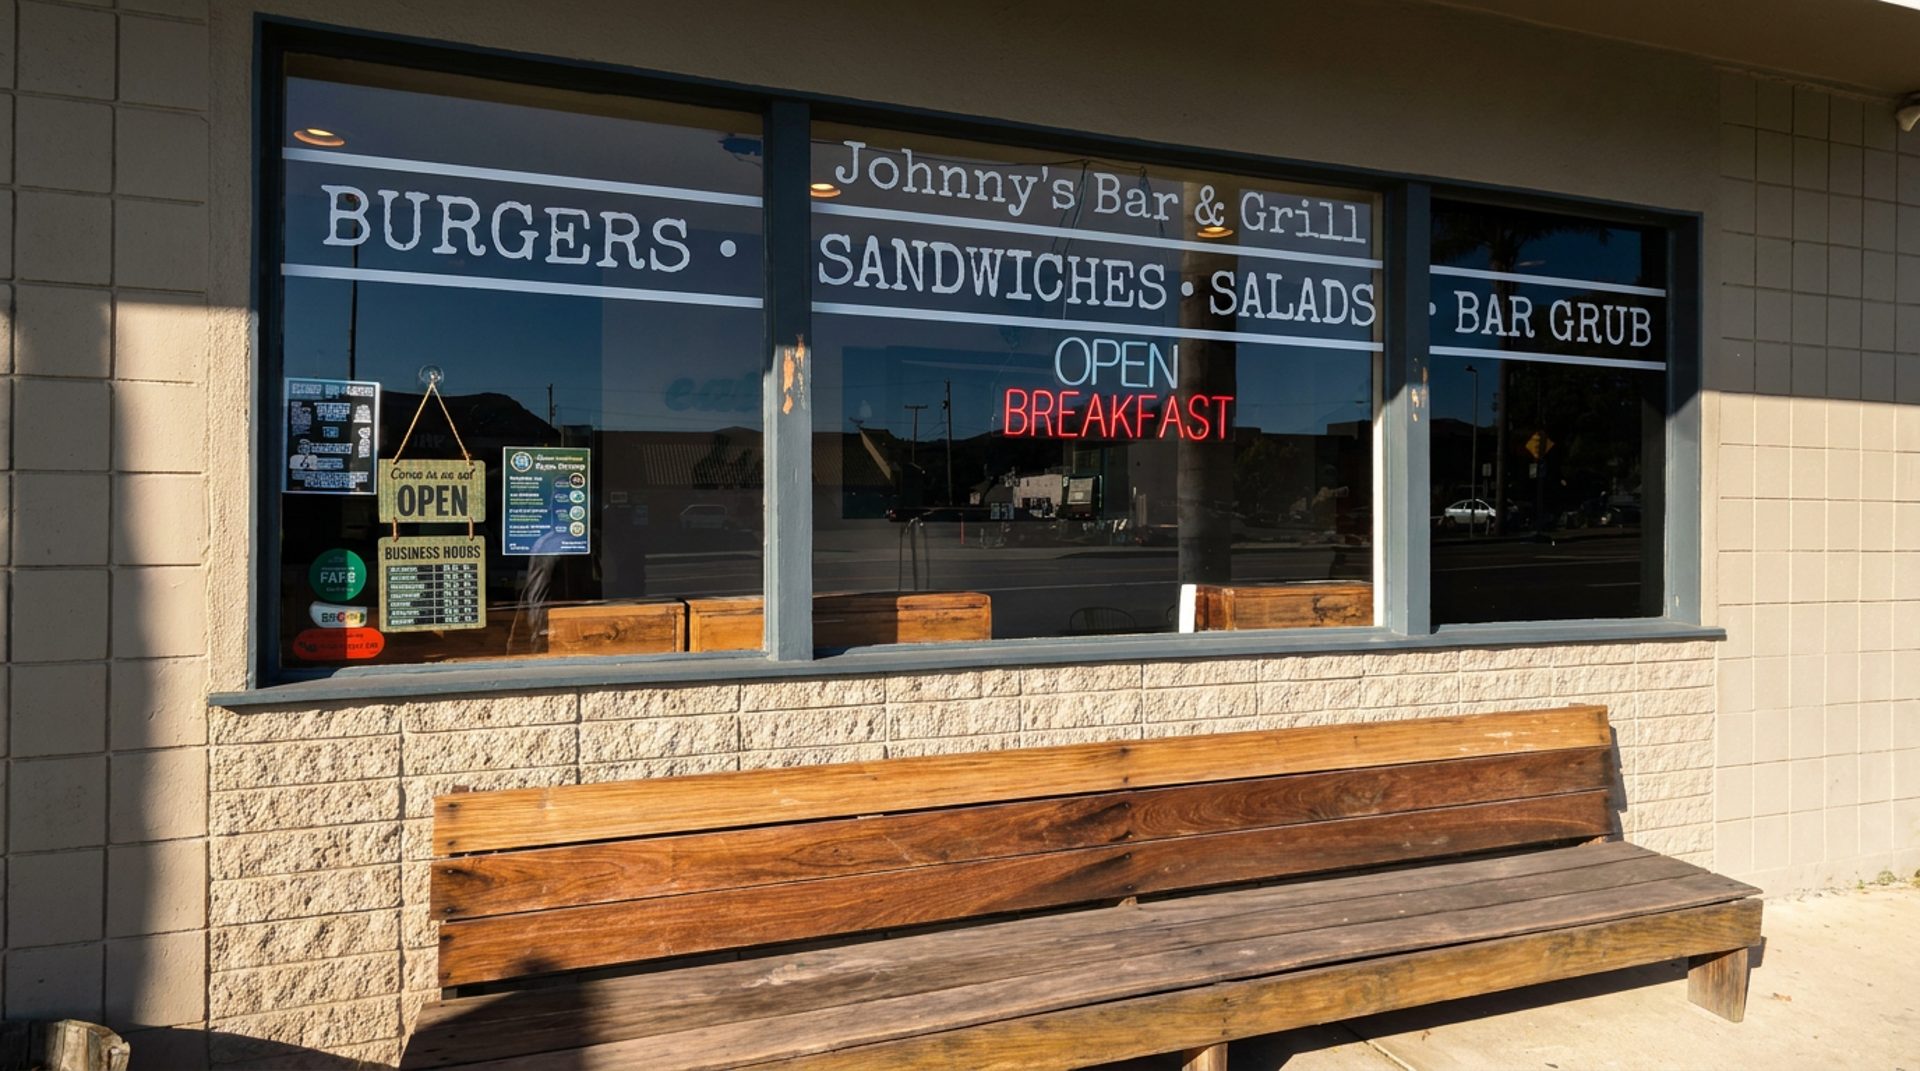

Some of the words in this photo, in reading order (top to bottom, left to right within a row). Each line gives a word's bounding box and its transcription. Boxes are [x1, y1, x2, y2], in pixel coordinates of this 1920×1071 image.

[835, 140, 1076, 217] Johnny's
[1093, 172, 1179, 222] Bar
[1194, 184, 1226, 227] &
[1240, 191, 1367, 244] Grill
[321, 184, 691, 274] BURGERS
[818, 233, 1168, 311] SANDWICHES
[1209, 270, 1377, 327] SALADS
[1453, 290, 1536, 339] BAR
[1549, 299, 1652, 348] GRUB
[1054, 336, 1179, 390] OPEN
[1003, 388, 1235, 441] BREAKFAST
[397, 484, 468, 517] OPEN
[384, 546, 440, 560] BUSINESS
